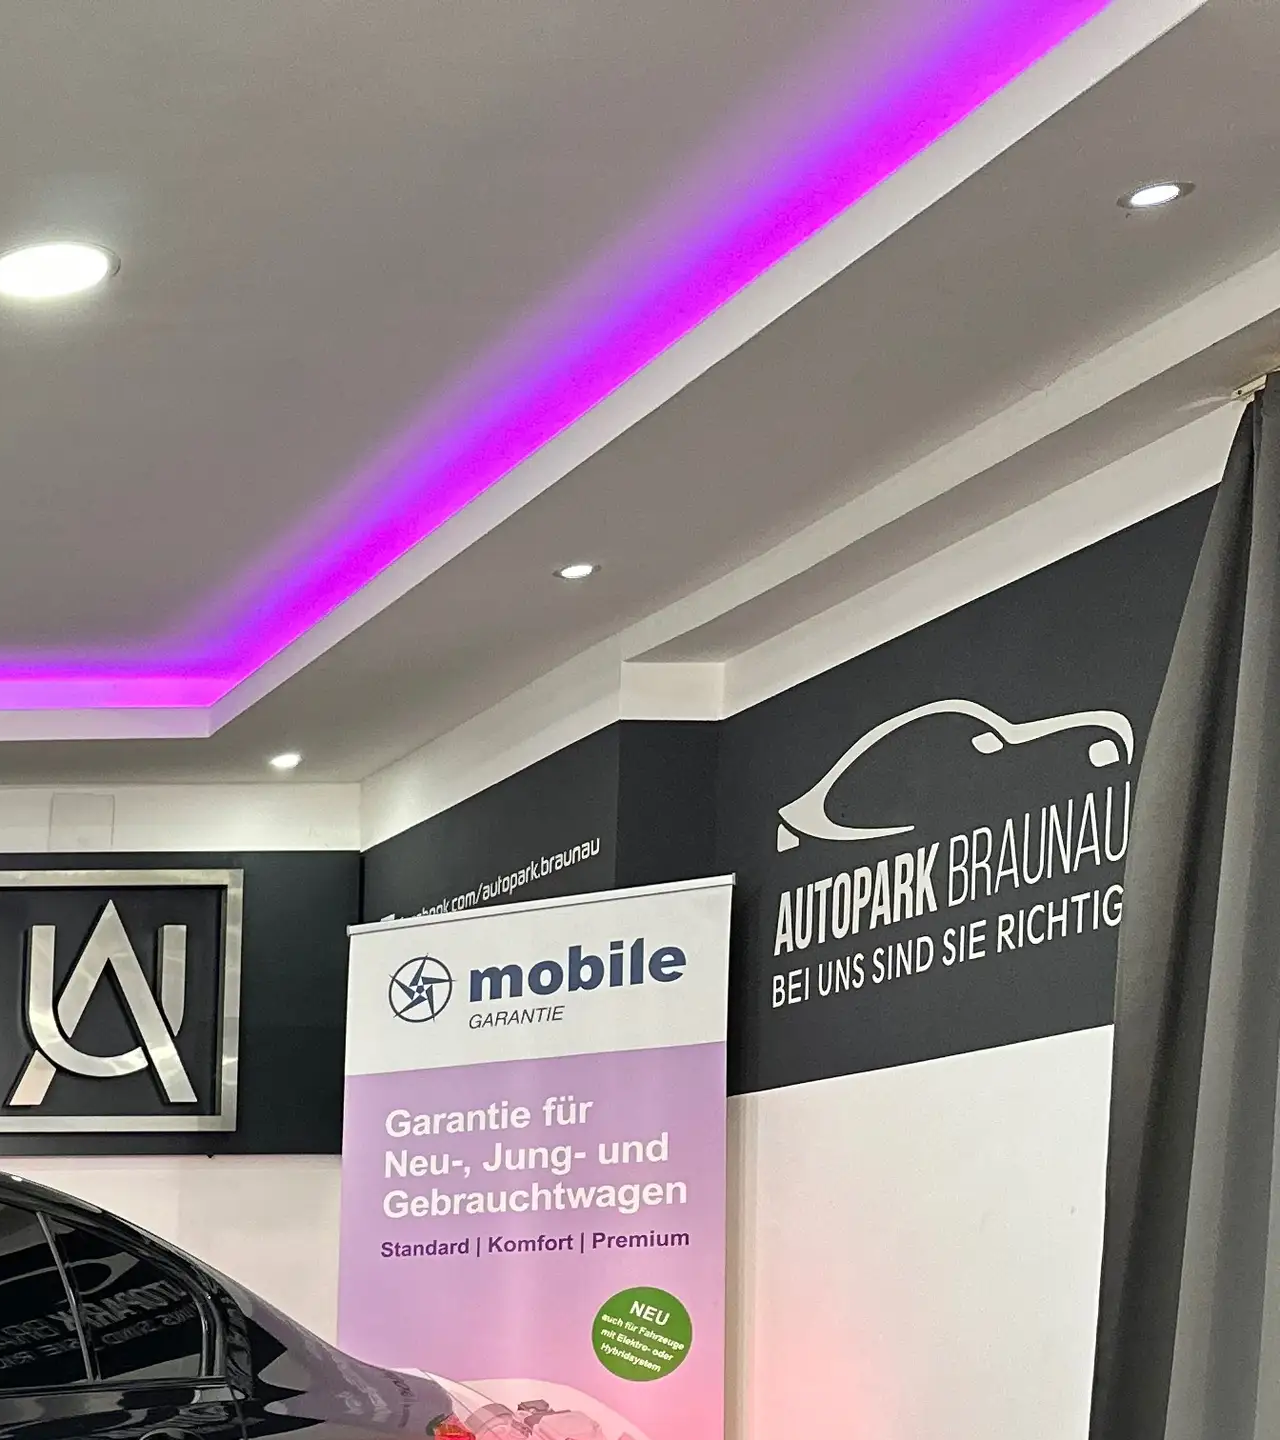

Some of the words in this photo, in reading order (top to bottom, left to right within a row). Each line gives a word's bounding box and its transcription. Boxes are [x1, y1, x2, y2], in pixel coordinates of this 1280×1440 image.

[774, 842, 940, 957] AUTOPARK
[949, 781, 1131, 908] BRAUNAU
[773, 967, 810, 1008] BEI
[819, 953, 865, 997] UNS
[872, 936, 934, 984] SIND
[942, 920, 987, 966] SIE
[997, 885, 1125, 953] RICHTIG
[469, 938, 687, 1002] mobile
[468, 1005, 565, 1029] GARANTIE
[385, 1100, 531, 1137] Garantie
[543, 1095, 594, 1127] für
[385, 1150, 471, 1178] Neu-,
[483, 1142, 587, 1175] Jung-
[598, 1132, 669, 1165] und
[383, 1180, 687, 1218] Gebrauchtwagen
[381, 1238, 469, 1258] Standard
[488, 1233, 573, 1253] Komfort
[592, 1230, 689, 1249] Premium
[629, 1300, 670, 1326] NEU
[600, 1328, 616, 1340] mit
[616, 1333, 651, 1352] Elektro-
[651, 1348, 674, 1361] oder
[601, 1314, 623, 1328] auch
[625, 1321, 638, 1333] für
[638, 1326, 685, 1351] Fahrzeuge
[600, 1342, 661, 1373] Hybridsystem
